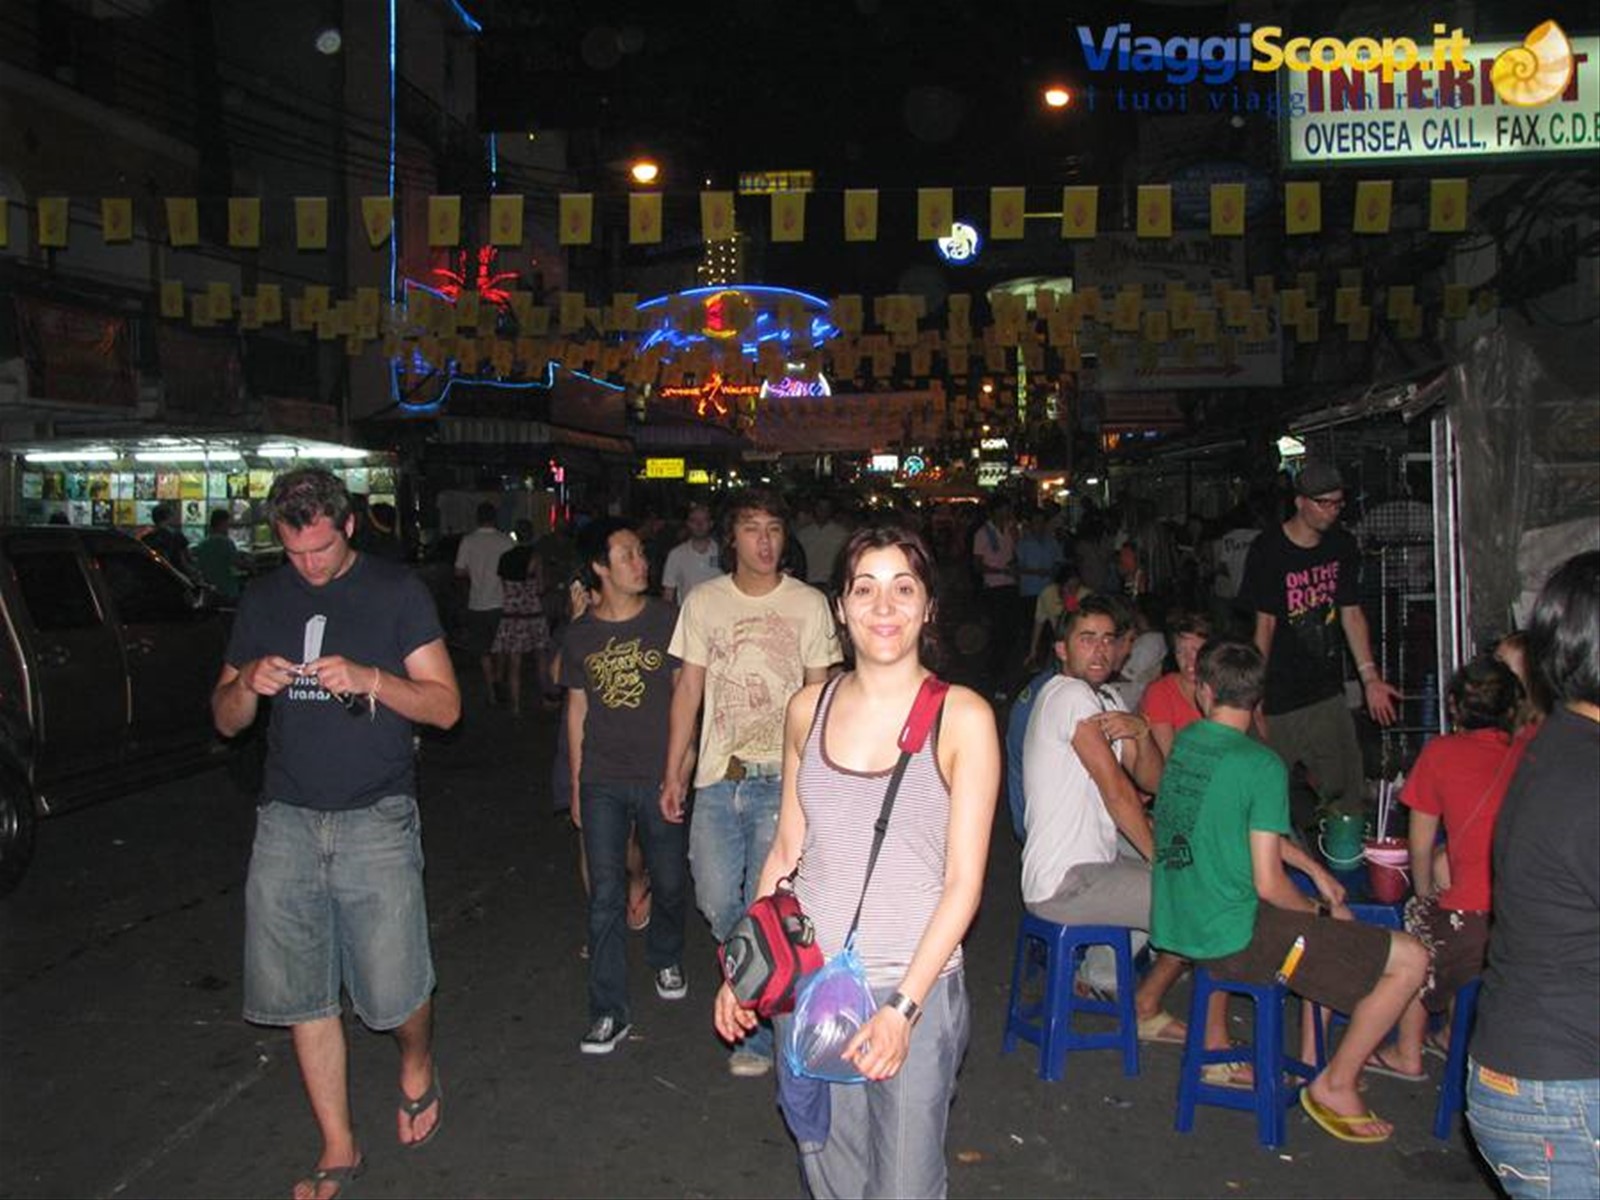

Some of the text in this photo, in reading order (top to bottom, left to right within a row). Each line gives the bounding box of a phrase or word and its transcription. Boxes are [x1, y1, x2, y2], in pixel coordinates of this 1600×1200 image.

[1308, 54, 1588, 113] INTERT
[1305, 121, 1412, 155] OVERSEA
[1422, 117, 1487, 150] CALL,
[1286, 561, 1339, 589] ON THE
